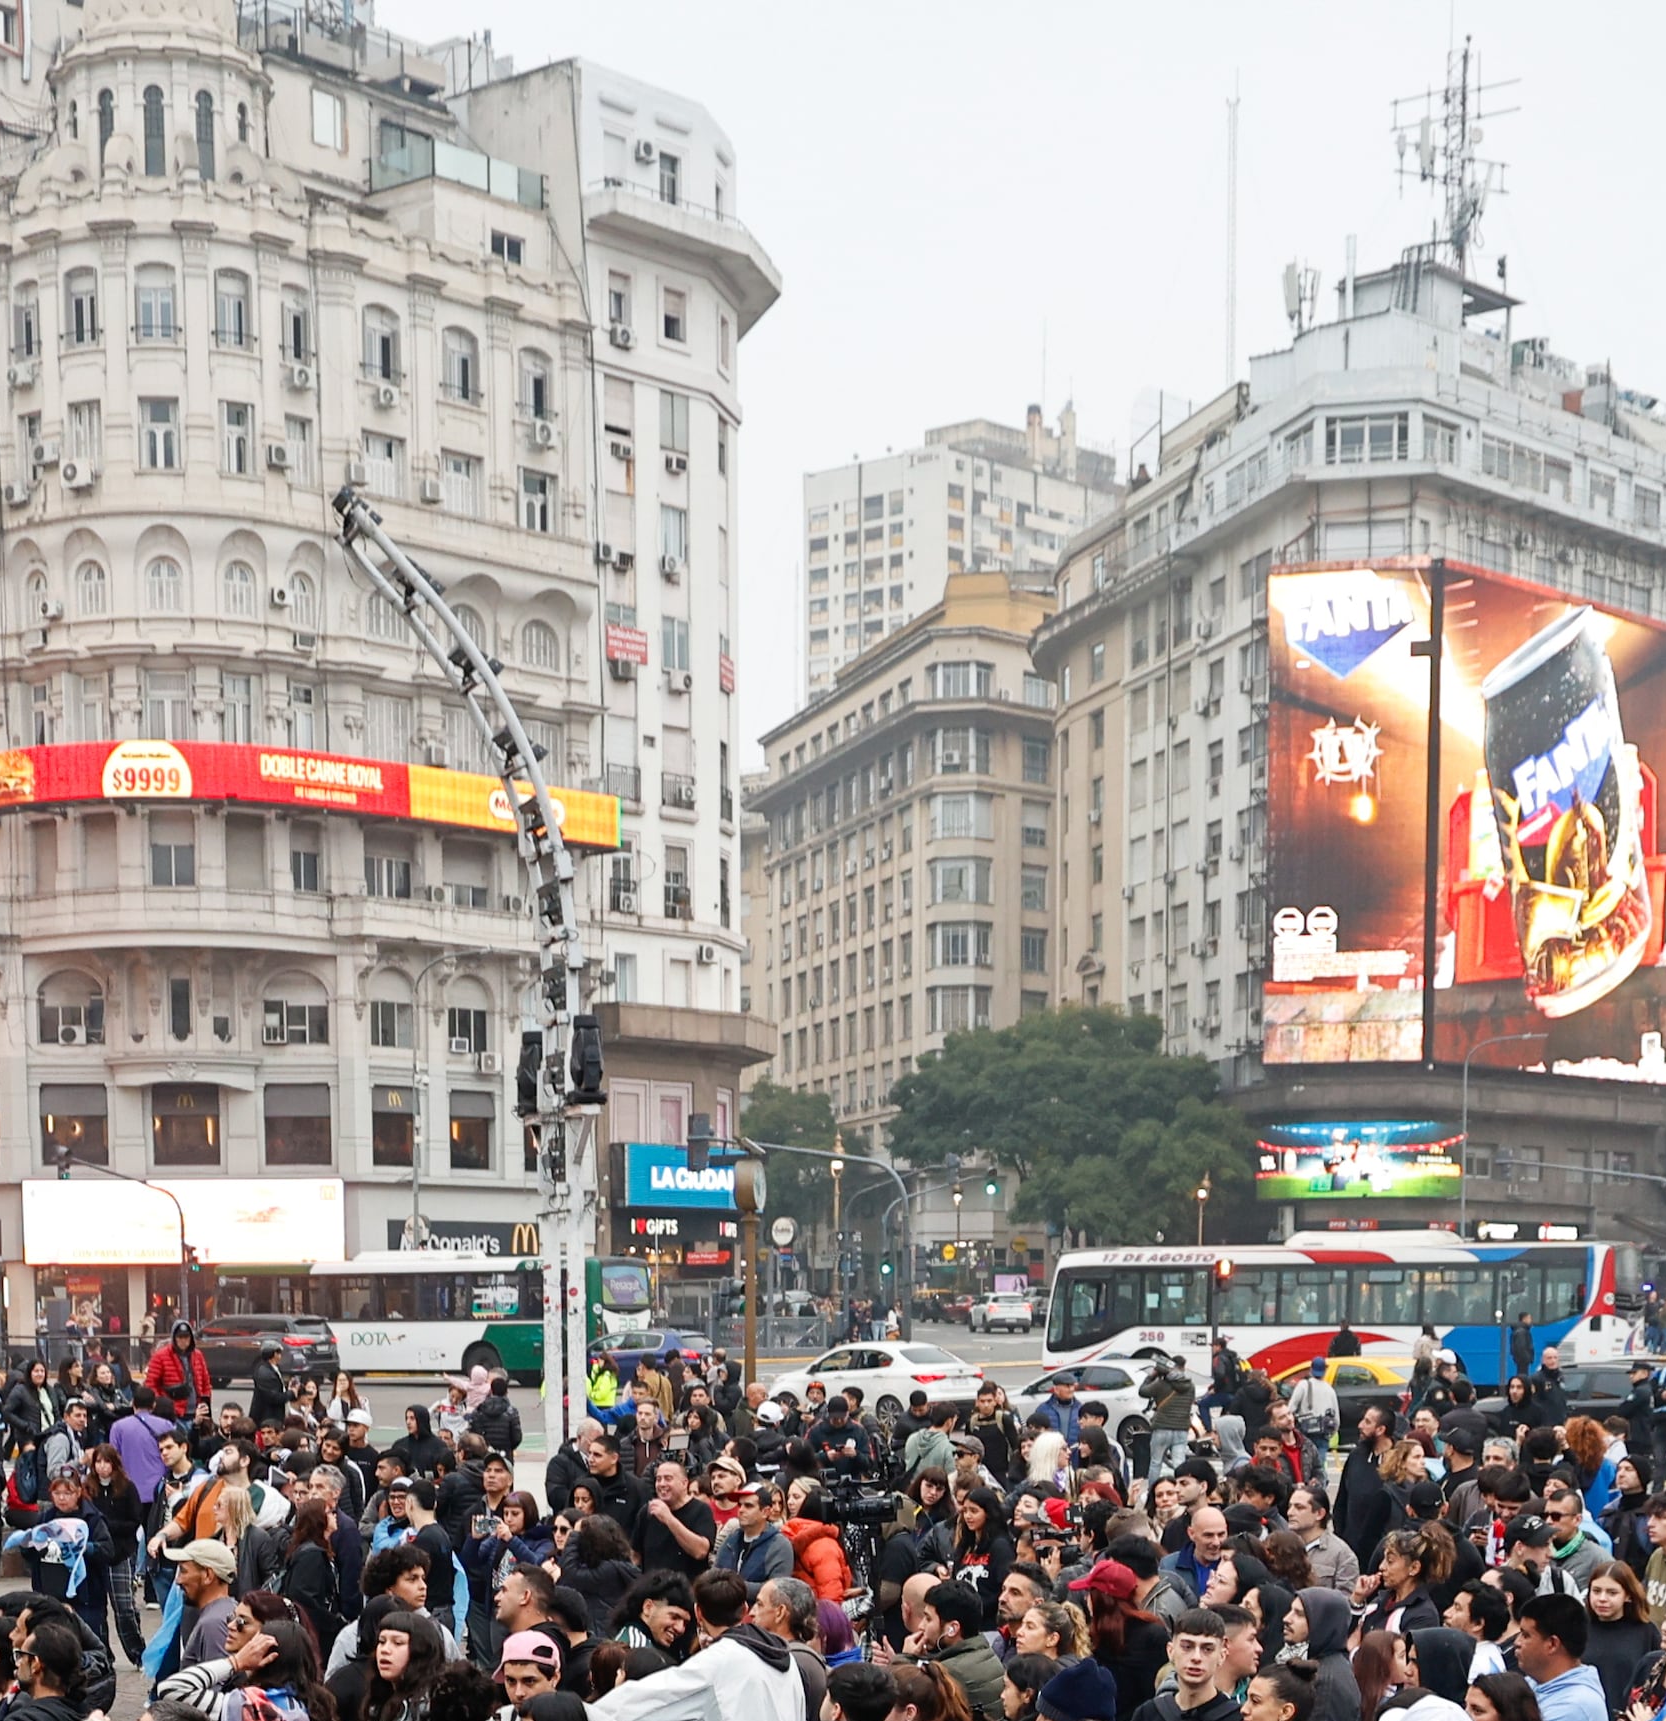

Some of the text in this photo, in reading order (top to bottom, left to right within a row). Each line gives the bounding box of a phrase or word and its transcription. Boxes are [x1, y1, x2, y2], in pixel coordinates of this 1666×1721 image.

[113, 766, 181, 792] $9999
[259, 753, 384, 790] DOBLE CARNE ROYAL
[651, 1165, 676, 1189] LA
[646, 1218, 679, 1236] GIFTS
[1102, 1253, 1216, 1262] 17 DE AGOSTO
[351, 1332, 392, 1346] DOTA
